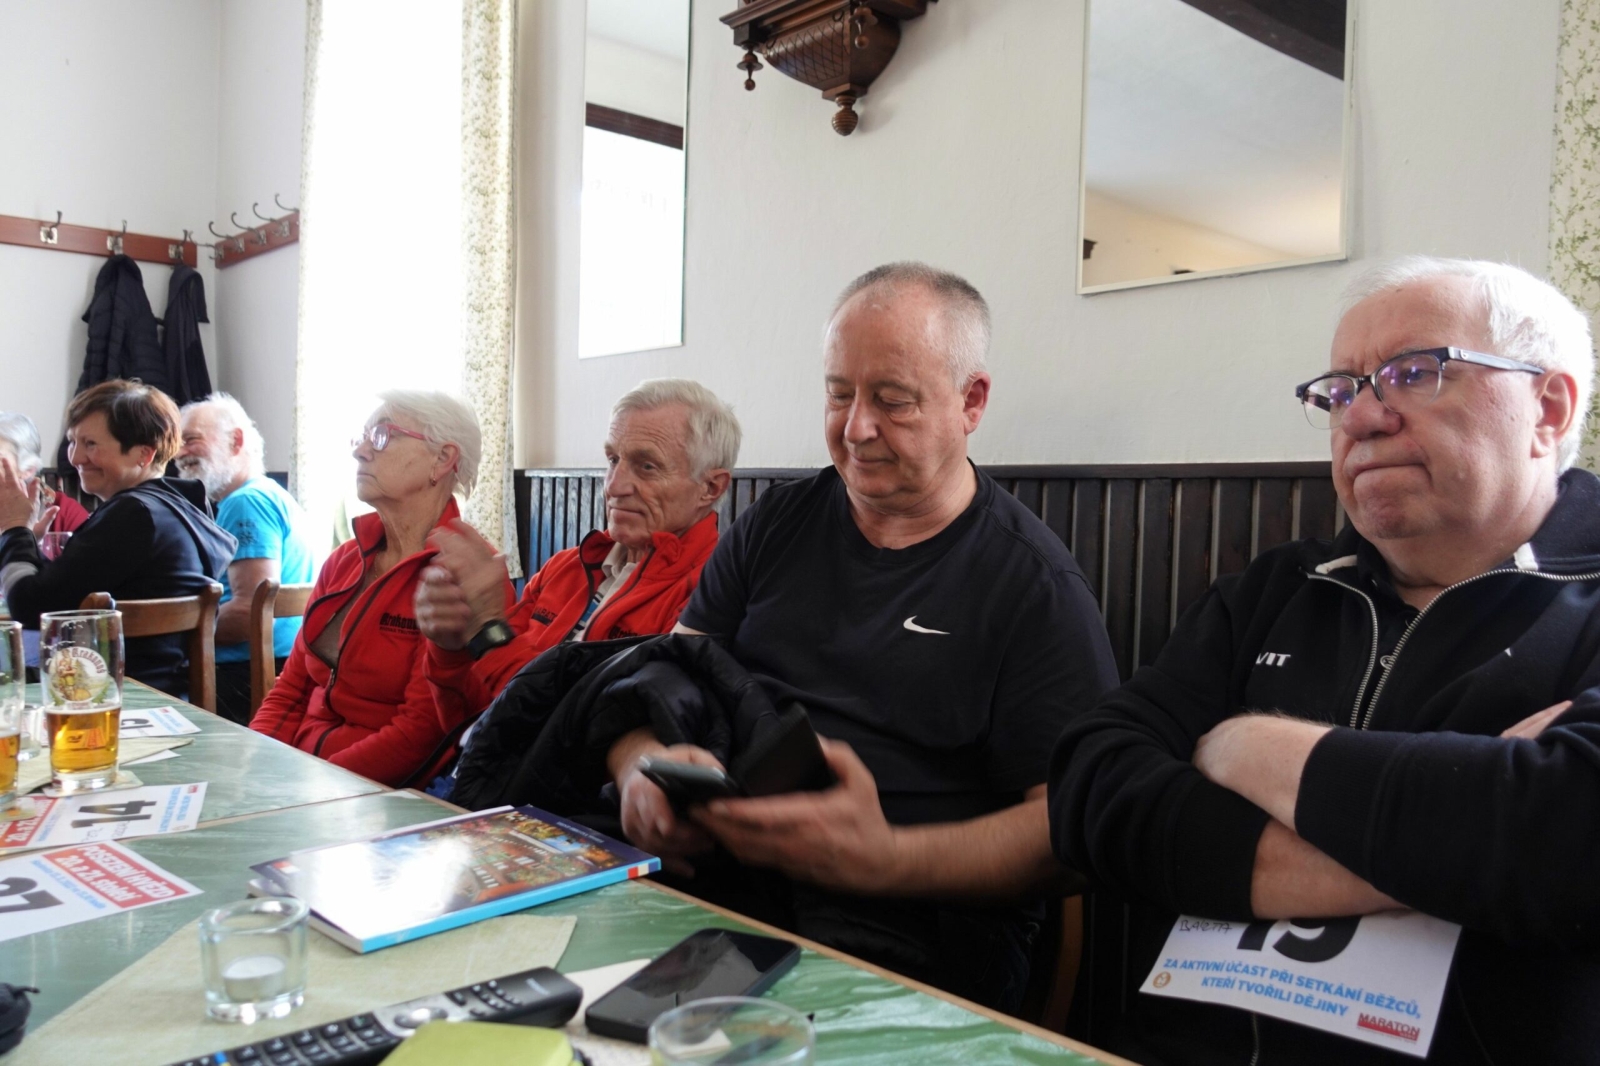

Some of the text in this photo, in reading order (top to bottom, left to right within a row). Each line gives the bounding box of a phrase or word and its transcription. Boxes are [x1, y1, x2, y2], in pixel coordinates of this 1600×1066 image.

[71, 799, 158, 829] 14
[1163, 958, 1422, 1020] ZA AKTIVNÍ ÚČAST PŘI SETKÁNÍ BĚŽCŮ,
[1201, 976, 1350, 1017] KTEŘÍ TVOŘILI DĚJINY
[1359, 1012, 1421, 1037] MARATON
